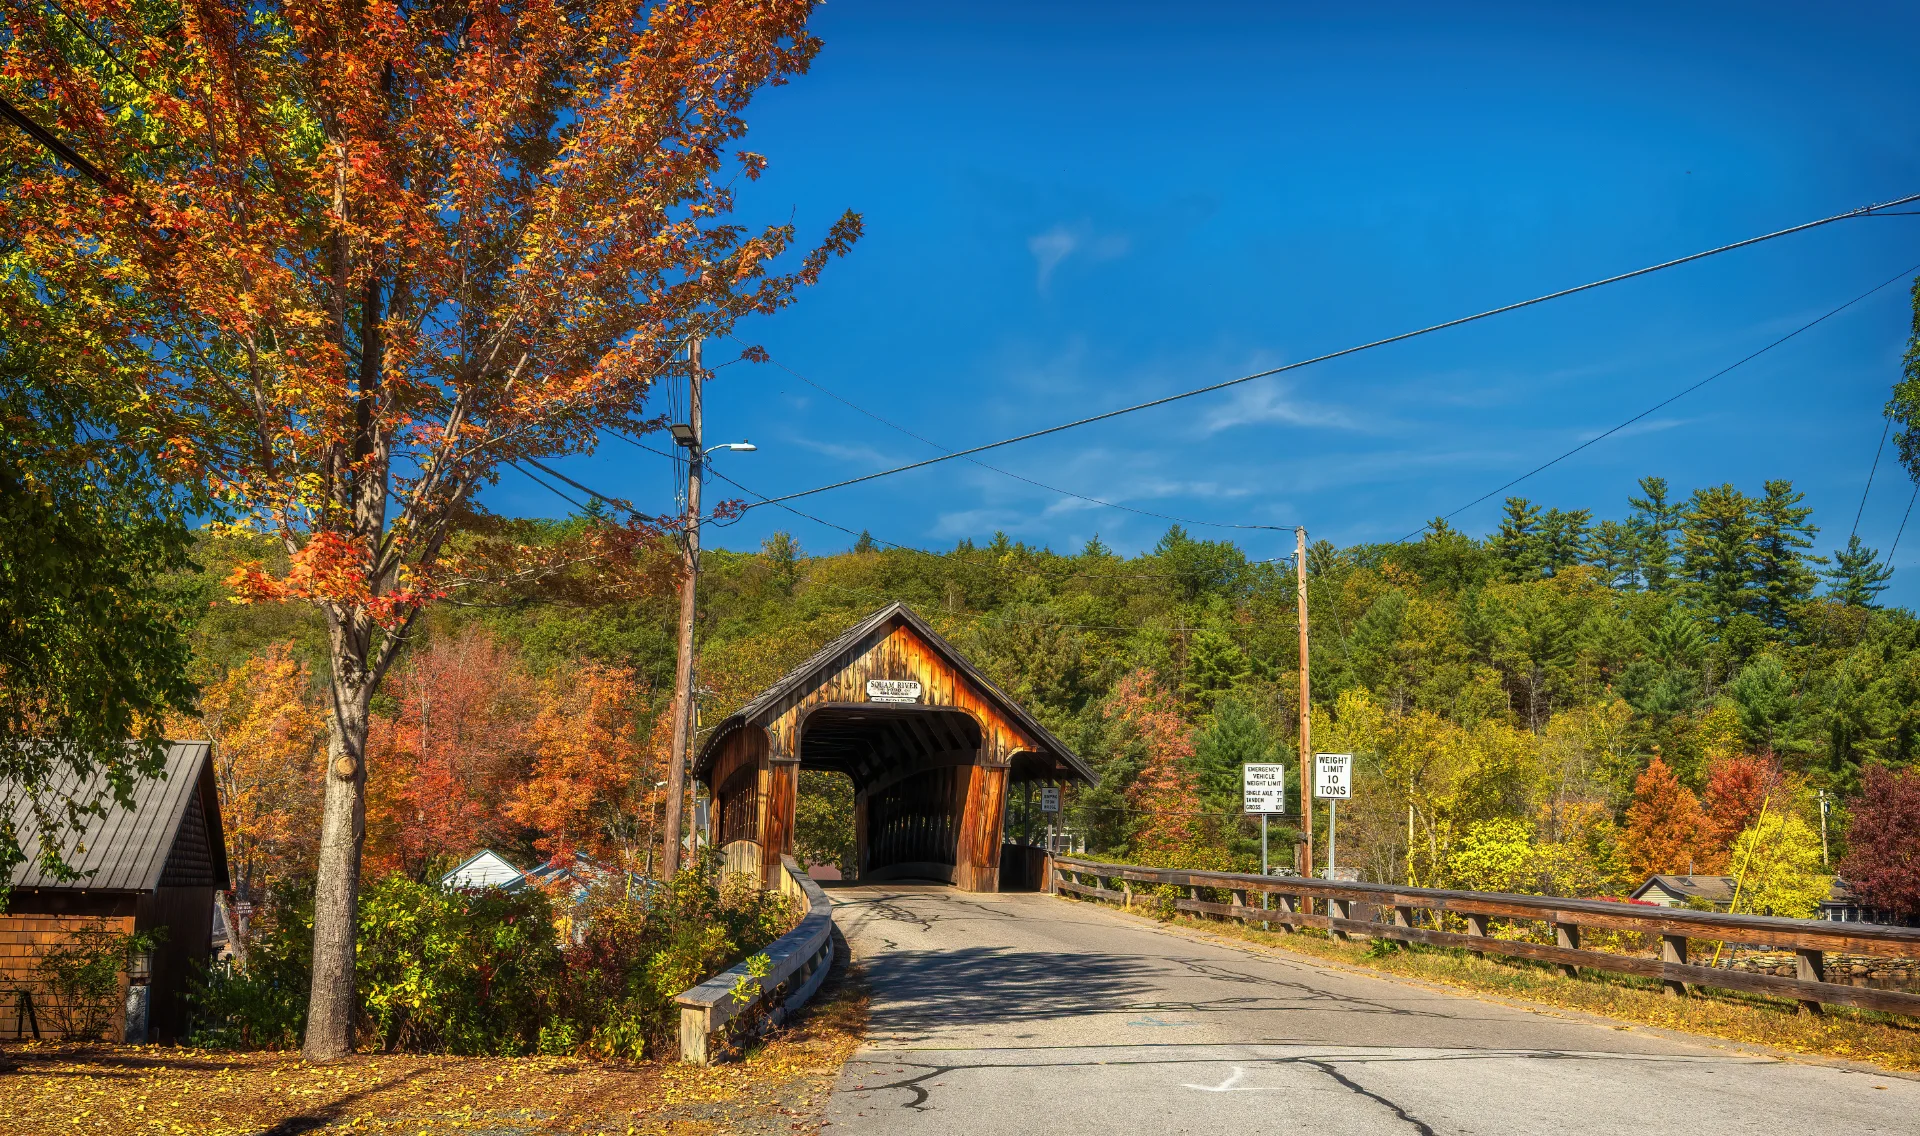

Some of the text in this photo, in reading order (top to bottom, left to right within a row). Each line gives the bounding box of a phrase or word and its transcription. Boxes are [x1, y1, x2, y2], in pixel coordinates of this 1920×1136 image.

[871, 681, 895, 689] SQUAM
[1319, 756, 1348, 764] WEIGHT
[1323, 765, 1344, 773] LIMIT
[1327, 775, 1339, 784] 10
[1320, 785, 1346, 795] TONS
